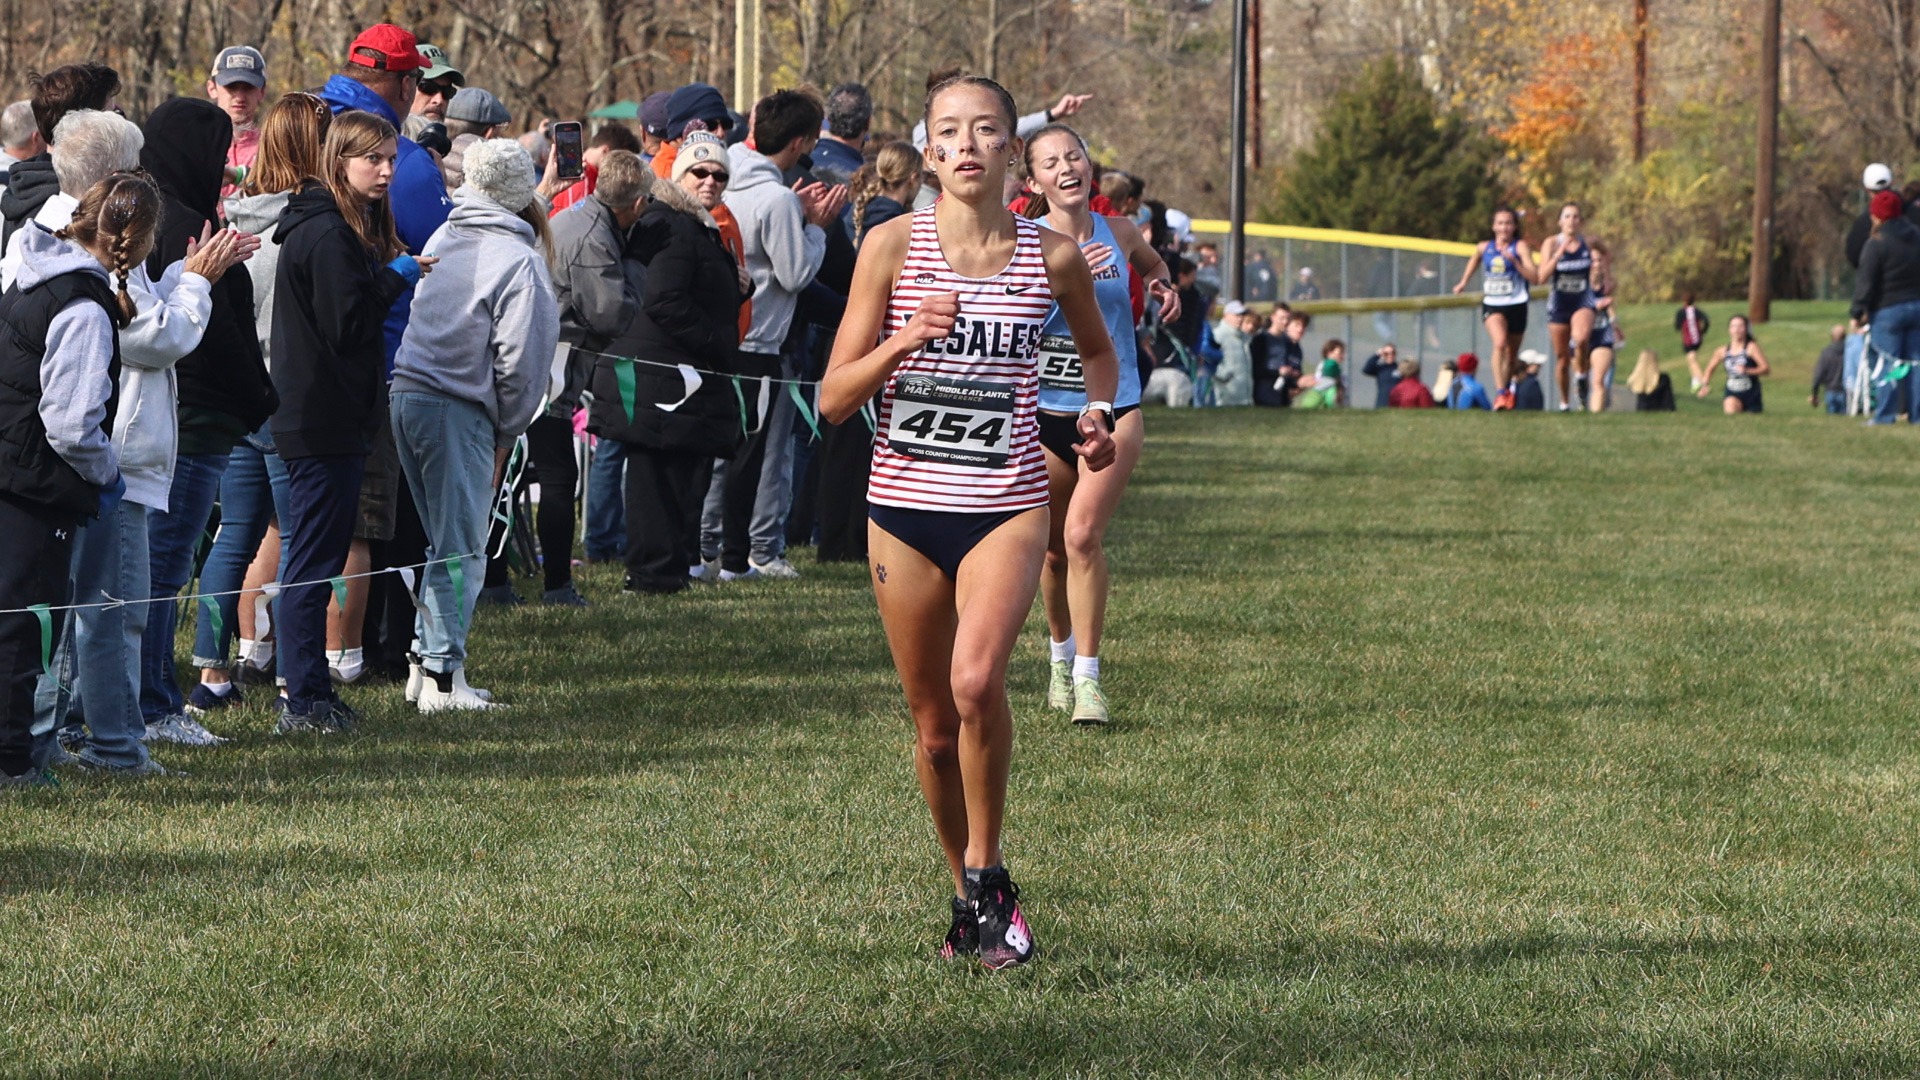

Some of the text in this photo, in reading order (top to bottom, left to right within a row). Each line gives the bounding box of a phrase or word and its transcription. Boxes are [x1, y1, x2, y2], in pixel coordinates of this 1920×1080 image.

[915, 276, 934, 284] MAC
[904, 314, 1039, 359] ESALES
[1043, 356, 1083, 378] 55
[904, 385, 932, 396] MAC
[933, 392, 983, 402] CONFERENCE
[935, 385, 1011, 399] MIDDLE ATLANTIC
[898, 410, 1006, 447] 454
[907, 447, 989, 462] CROSS COUNTRY CHAMPIONSHIP
